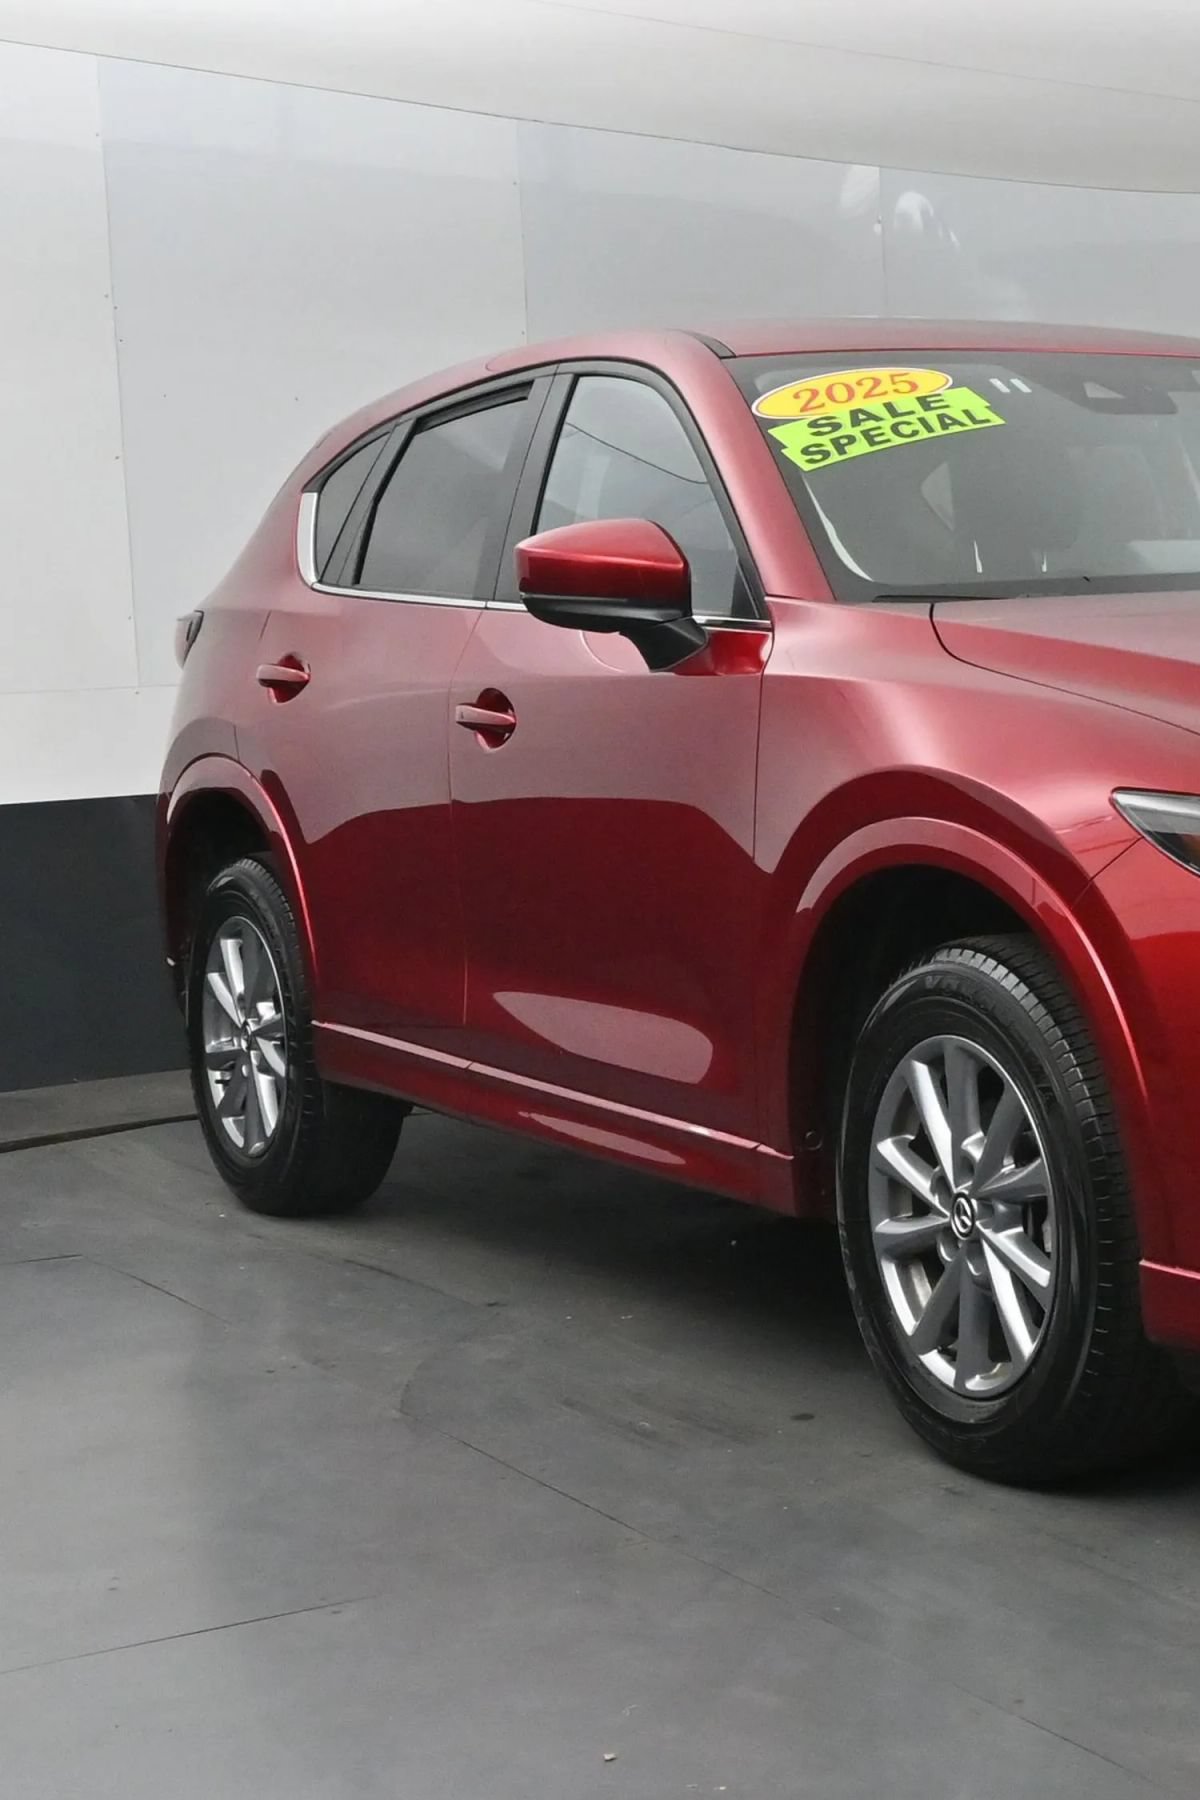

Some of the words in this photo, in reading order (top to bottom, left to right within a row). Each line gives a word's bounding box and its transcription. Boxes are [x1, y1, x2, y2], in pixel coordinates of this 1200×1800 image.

[793, 372, 919, 413] 2025
[800, 409, 991, 465] SPECIAL
[806, 394, 950, 437] SALE
